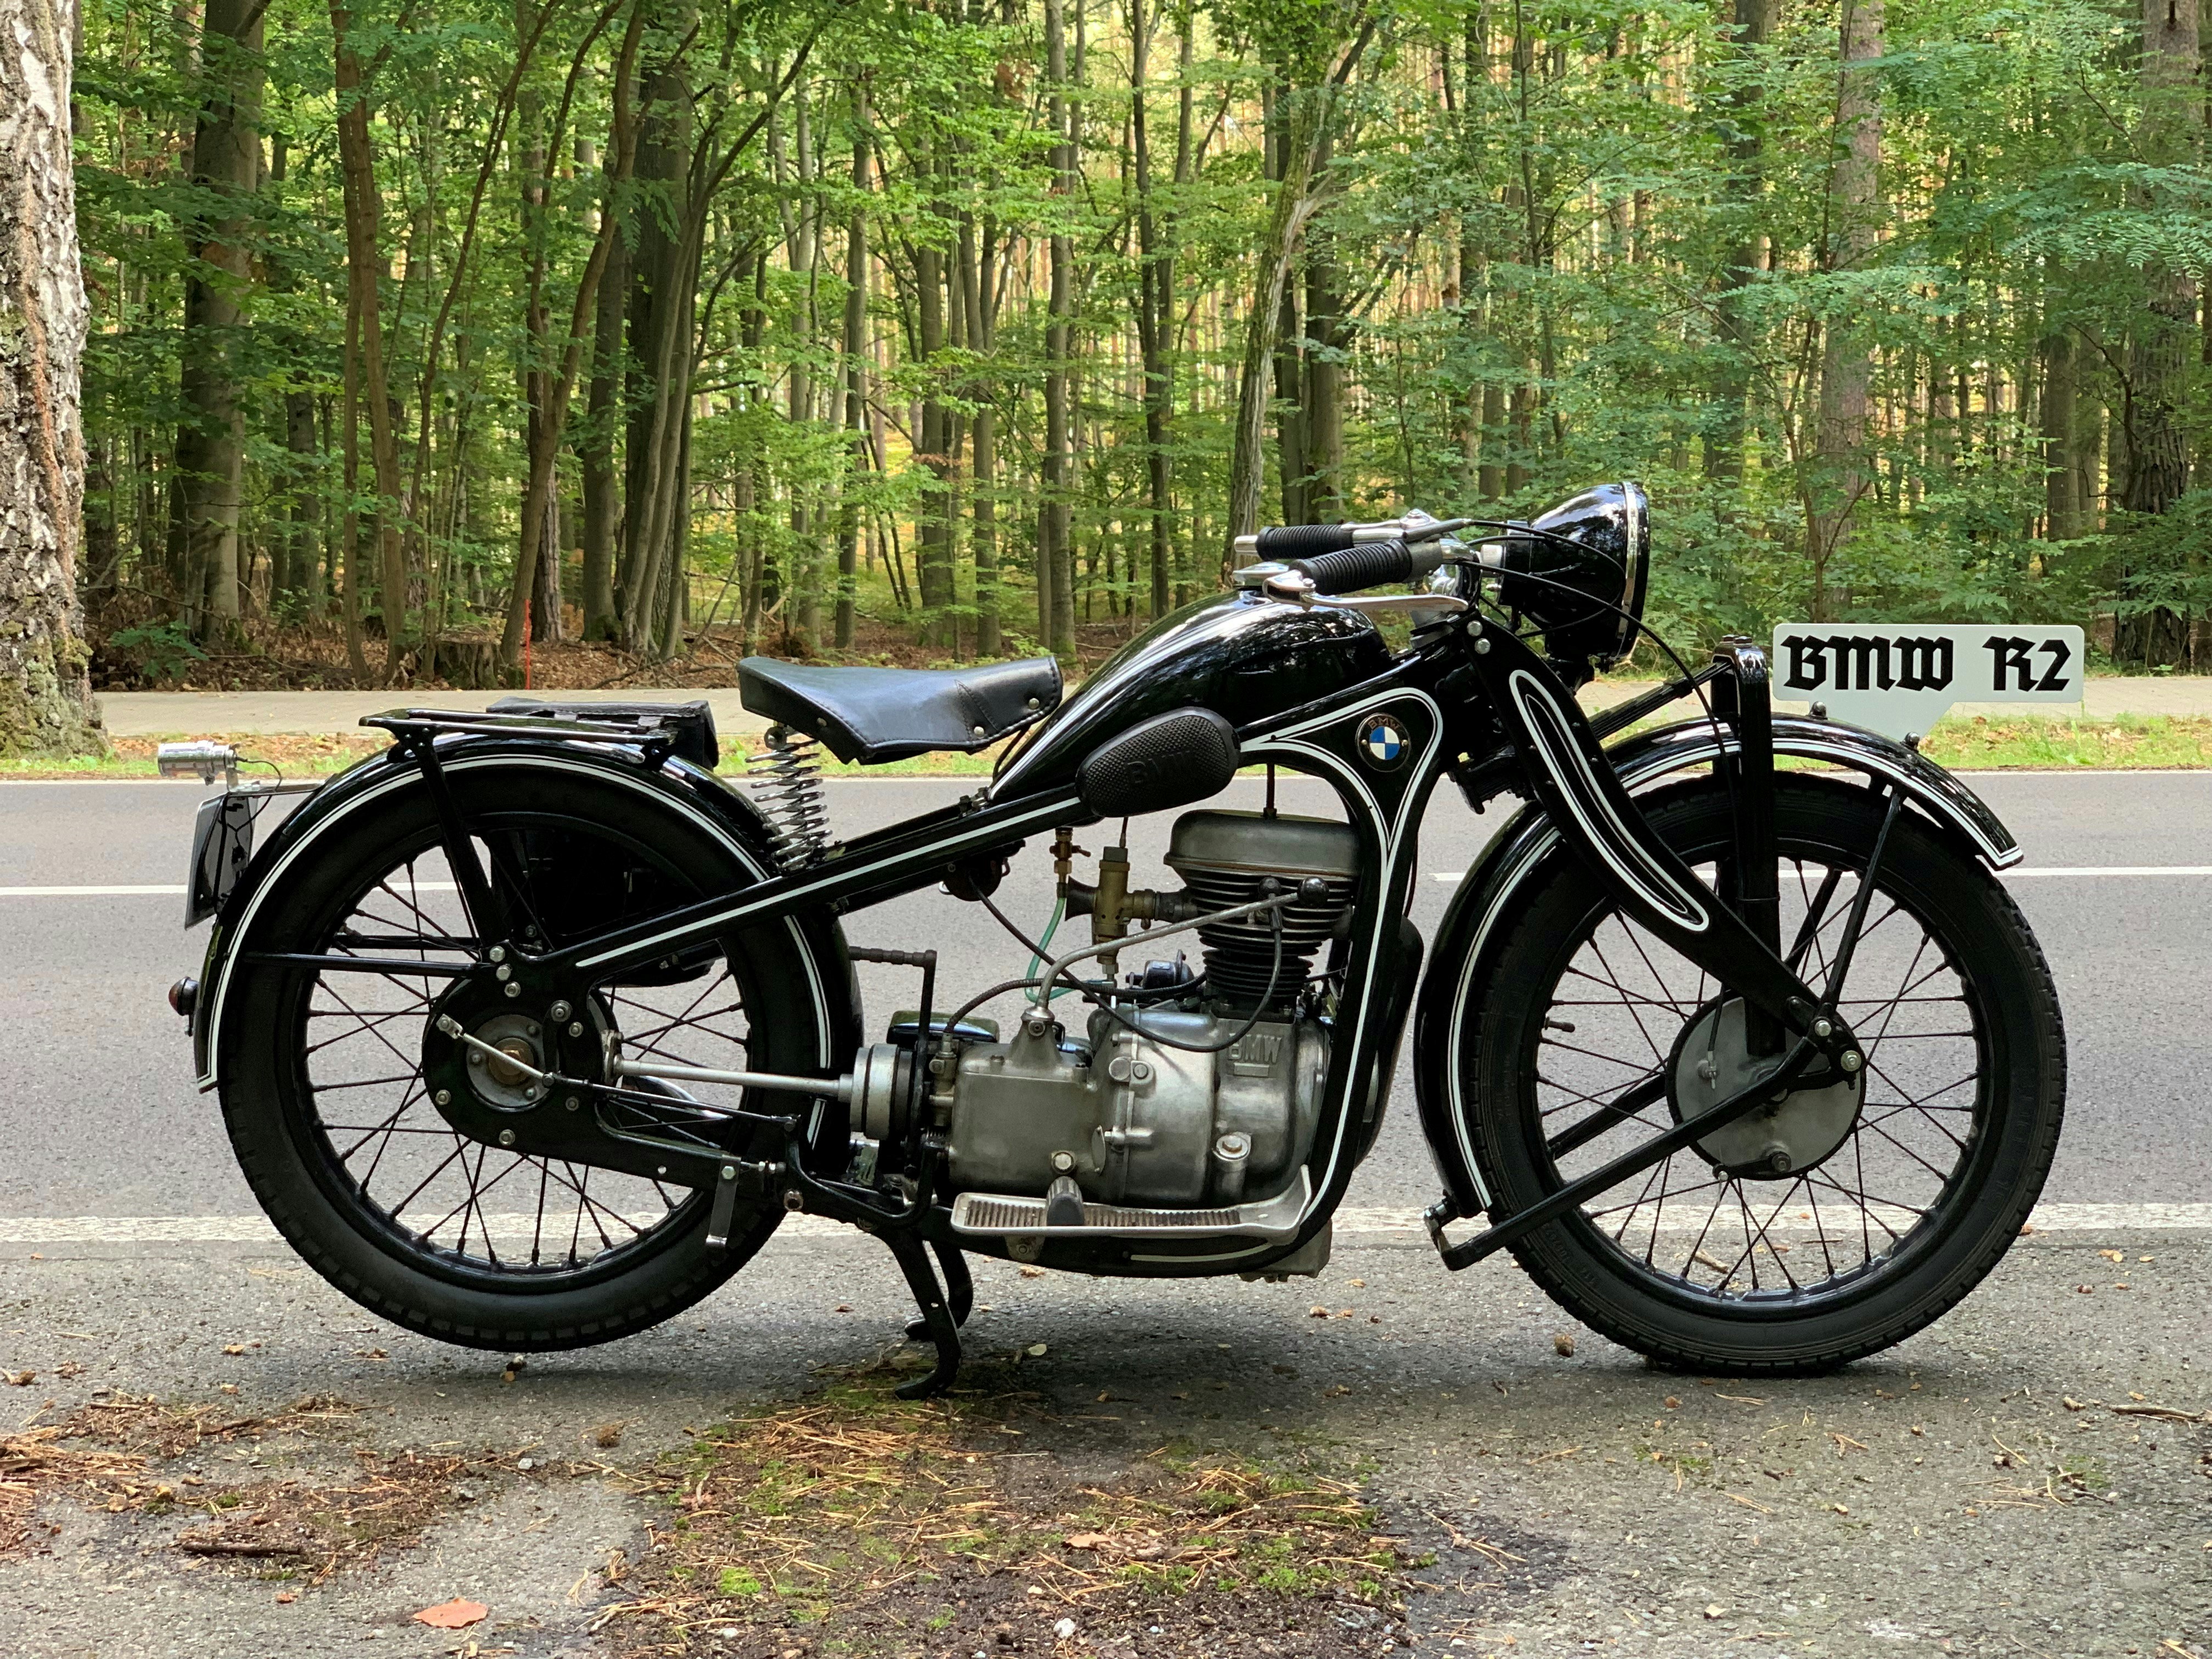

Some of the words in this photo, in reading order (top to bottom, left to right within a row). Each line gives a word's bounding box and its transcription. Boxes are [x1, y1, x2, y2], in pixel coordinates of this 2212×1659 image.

[1781, 635, 1954, 691] BMW
[1982, 636, 2071, 692] R2
[1368, 717, 1400, 730] BMW
[1228, 1033, 1282, 1063] BMW
